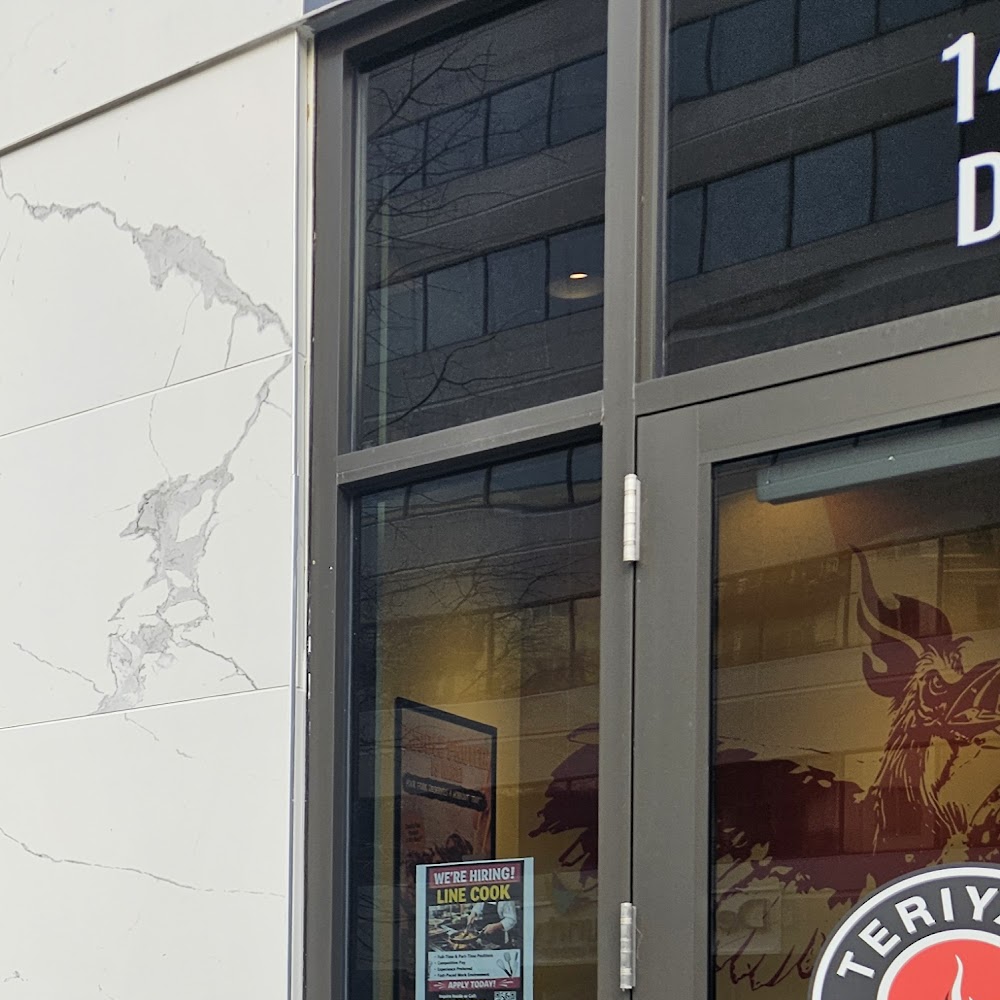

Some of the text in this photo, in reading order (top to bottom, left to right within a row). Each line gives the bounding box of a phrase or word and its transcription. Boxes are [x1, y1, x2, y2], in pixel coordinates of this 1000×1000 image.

[941, 32, 1000, 123] 1
[433, 866, 515, 885] WE'RE HIRING!
[436, 884, 511, 904] LINE COOK
[836, 885, 1000, 980] TERIY
[448, 979, 496, 989] APPLY TODAY!
